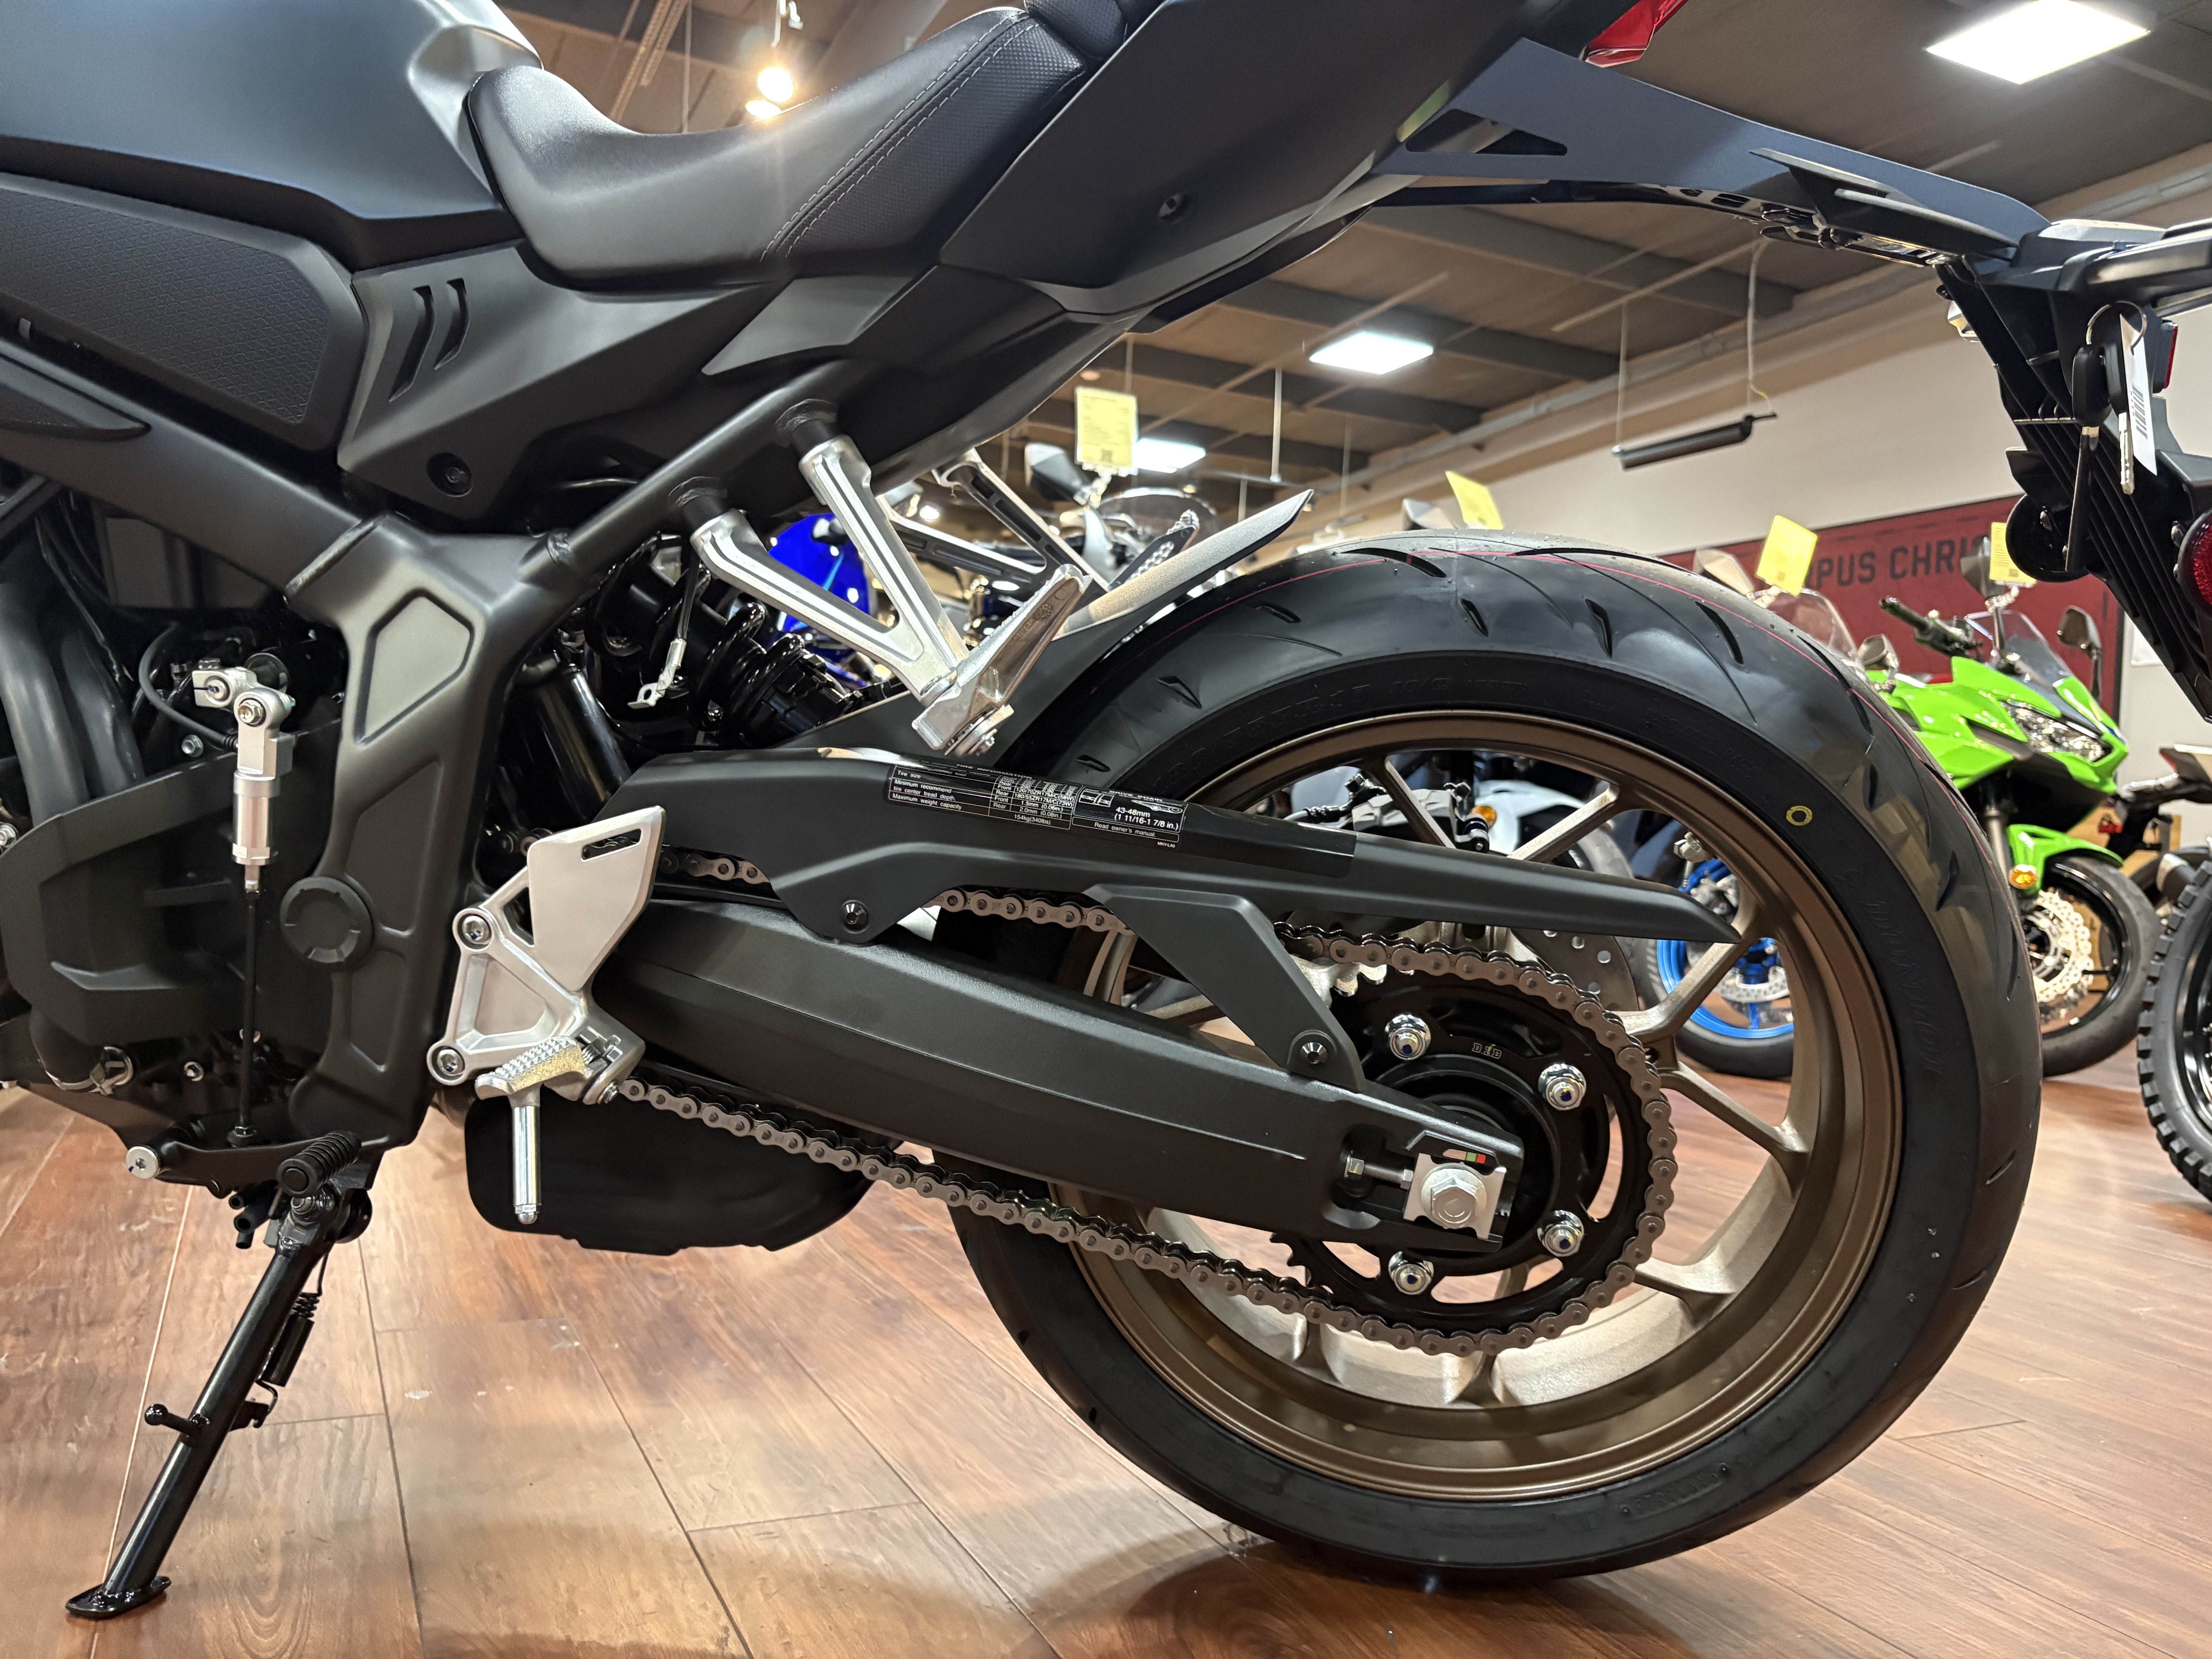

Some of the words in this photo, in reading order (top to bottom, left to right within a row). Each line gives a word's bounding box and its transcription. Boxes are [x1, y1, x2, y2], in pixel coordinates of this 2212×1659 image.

[894, 779, 918, 788] Minimum
[921, 785, 952, 793] recommend
[893, 793, 918, 802] Maximum
[921, 798, 938, 807] weight
[940, 802, 962, 811] capacity
[1116, 806, 1151, 818] 43-48mm
[1114, 812, 1121, 821] (1
[1125, 814, 1151, 825] 11/16-1
[1153, 819, 1165, 828] 7/8
[1166, 821, 1179, 831] in.)
